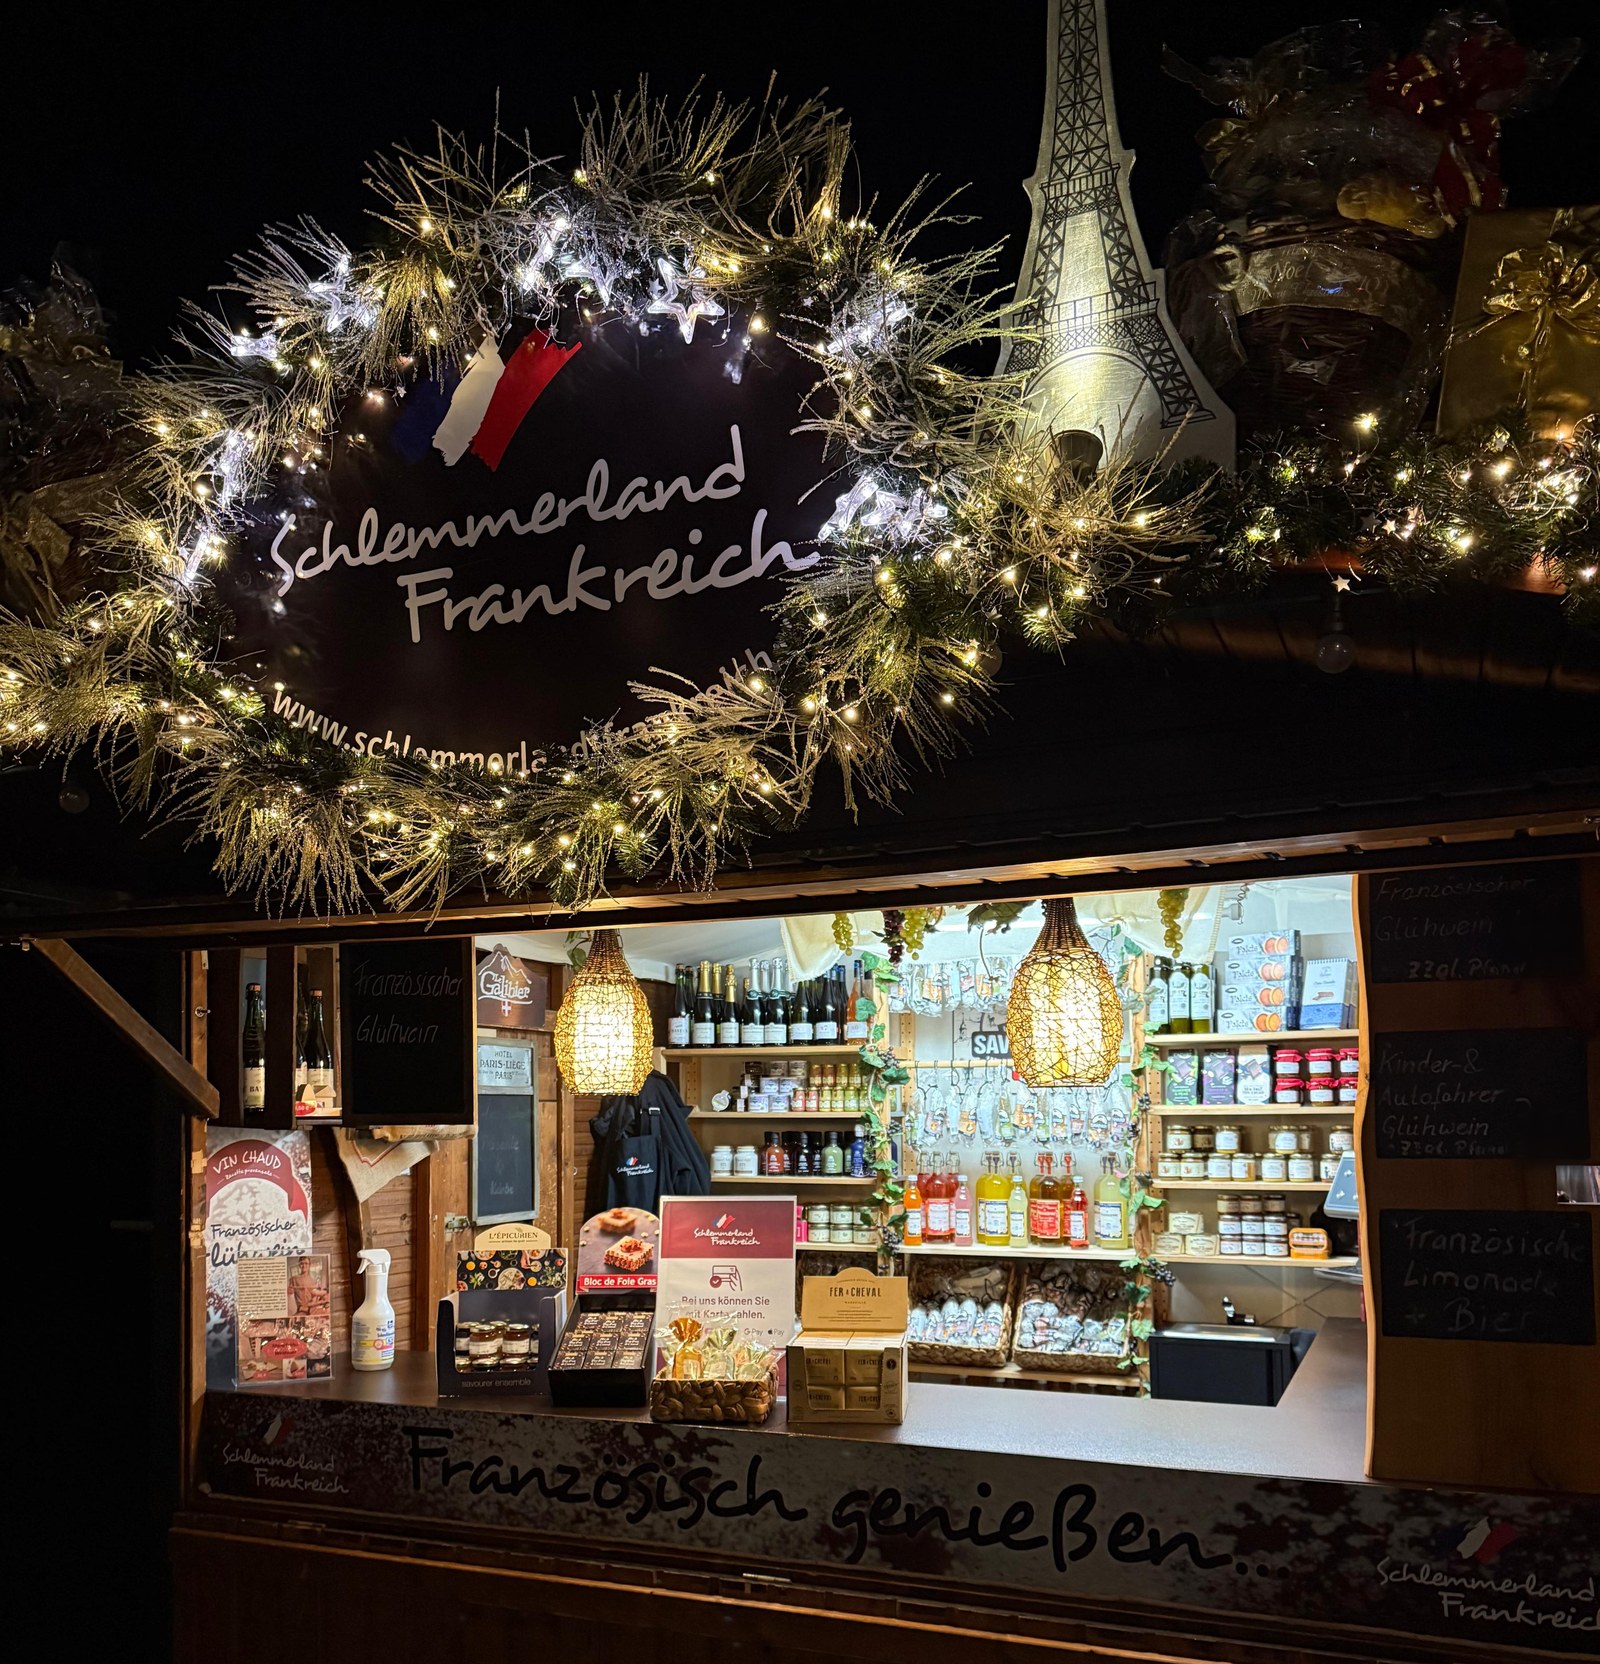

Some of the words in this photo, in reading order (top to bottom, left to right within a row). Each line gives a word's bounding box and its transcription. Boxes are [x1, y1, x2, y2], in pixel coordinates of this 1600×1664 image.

[270, 424, 748, 598] Schlemmerland
[396, 508, 822, 644] Frankreich
[353, 958, 464, 997] Französischer
[480, 971, 531, 999] Galibier
[974, 1034, 1010, 1054] SAV
[1379, 1083, 1504, 1110] Autofahrer
[213, 1155, 238, 1175] VIN
[242, 1150, 281, 1169] CHAUD
[210, 1218, 296, 1239] Französischer
[694, 1228, 753, 1238] Schlemmerland
[711, 1236, 760, 1245] Frankreich
[1402, 1215, 1585, 1262] Französische
[584, 1275, 602, 1286] Bloc
[604, 1275, 615, 1286] de
[617, 1277, 635, 1286] Foie
[637, 1277, 657, 1286] Gras
[829, 1287, 844, 1297] FER
[851, 1287, 881, 1297] CHEVAL
[700, 1298, 717, 1306] uns
[718, 1296, 753, 1306] können
[754, 1296, 770, 1306] Sie
[223, 1443, 335, 1473] Schlemmerland
[254, 1468, 350, 1495] Frankreich
[402, 1426, 808, 1530] Französisch
[1377, 1556, 1596, 1601] Schlemmerland
